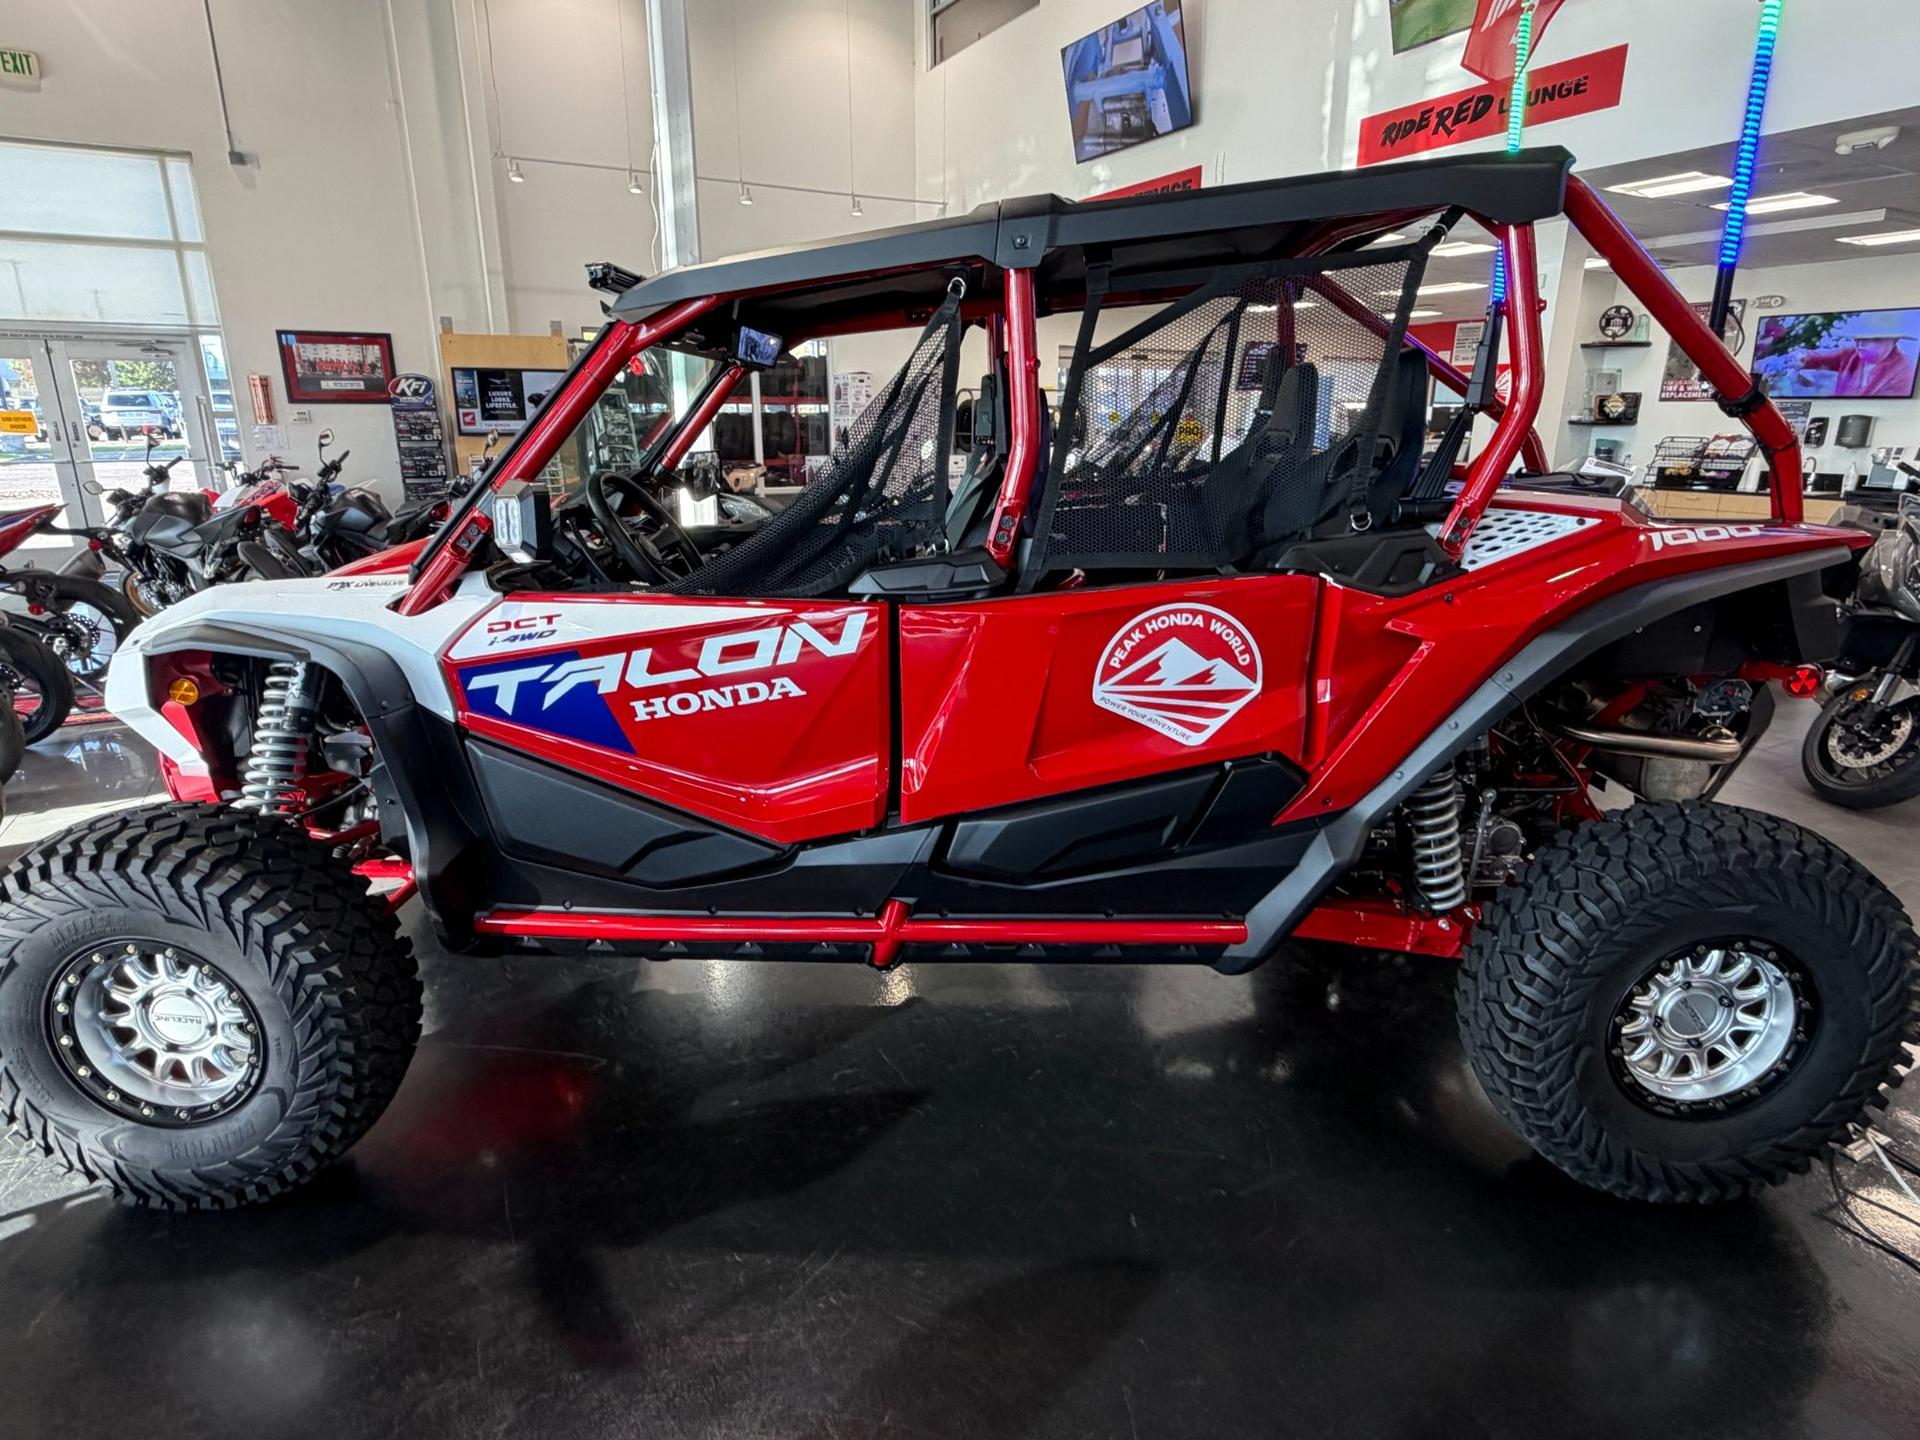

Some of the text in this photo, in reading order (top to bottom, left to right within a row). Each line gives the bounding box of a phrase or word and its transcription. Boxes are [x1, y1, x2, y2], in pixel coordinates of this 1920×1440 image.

[0, 51, 32, 76] EXIT
[1380, 76, 1589, 147] RIDE RED LUNGE
[1648, 525, 1761, 551] 1000
[488, 614, 561, 633] DCT
[1109, 613, 1251, 669] PEAK HONDA WORLD
[467, 612, 868, 716] TALON
[629, 678, 806, 722] HONDA
[1100, 696, 1193, 742] POWER YOUR ADVENTURE
